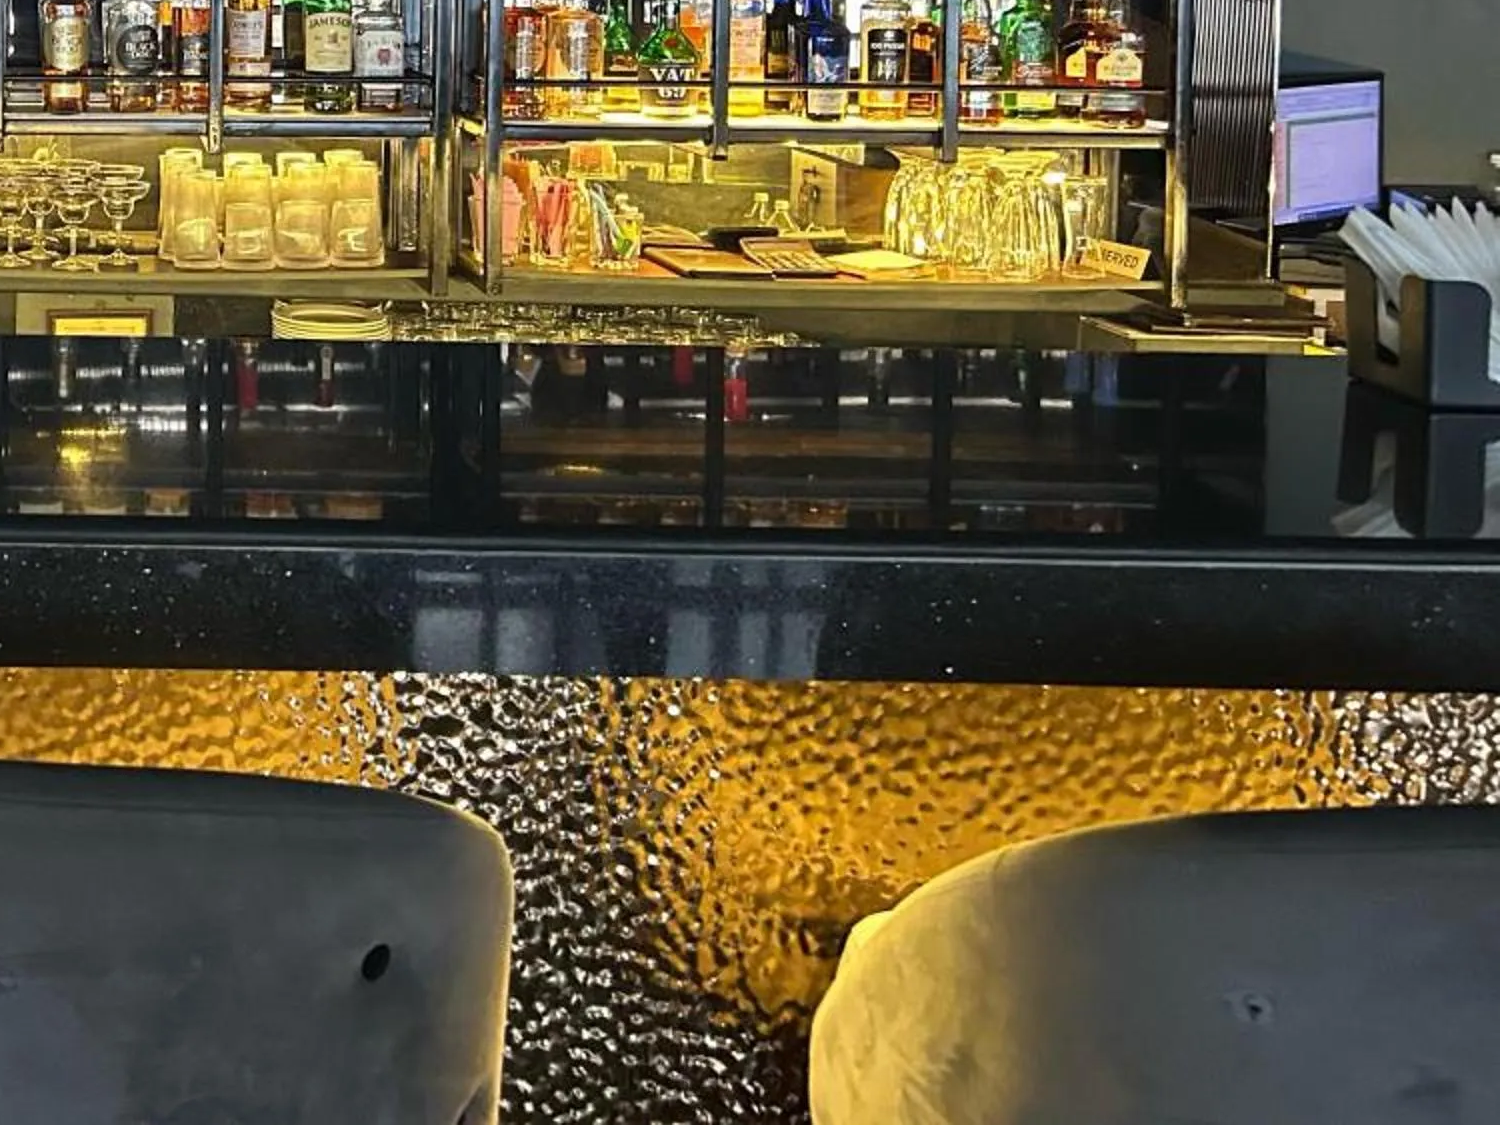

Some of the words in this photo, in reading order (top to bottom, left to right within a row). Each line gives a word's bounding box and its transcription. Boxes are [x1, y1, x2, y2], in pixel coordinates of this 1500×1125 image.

[308, 16, 351, 29] JAMESO
[649, 68, 695, 81] VAT
[1087, 246, 1140, 269] ERVED
